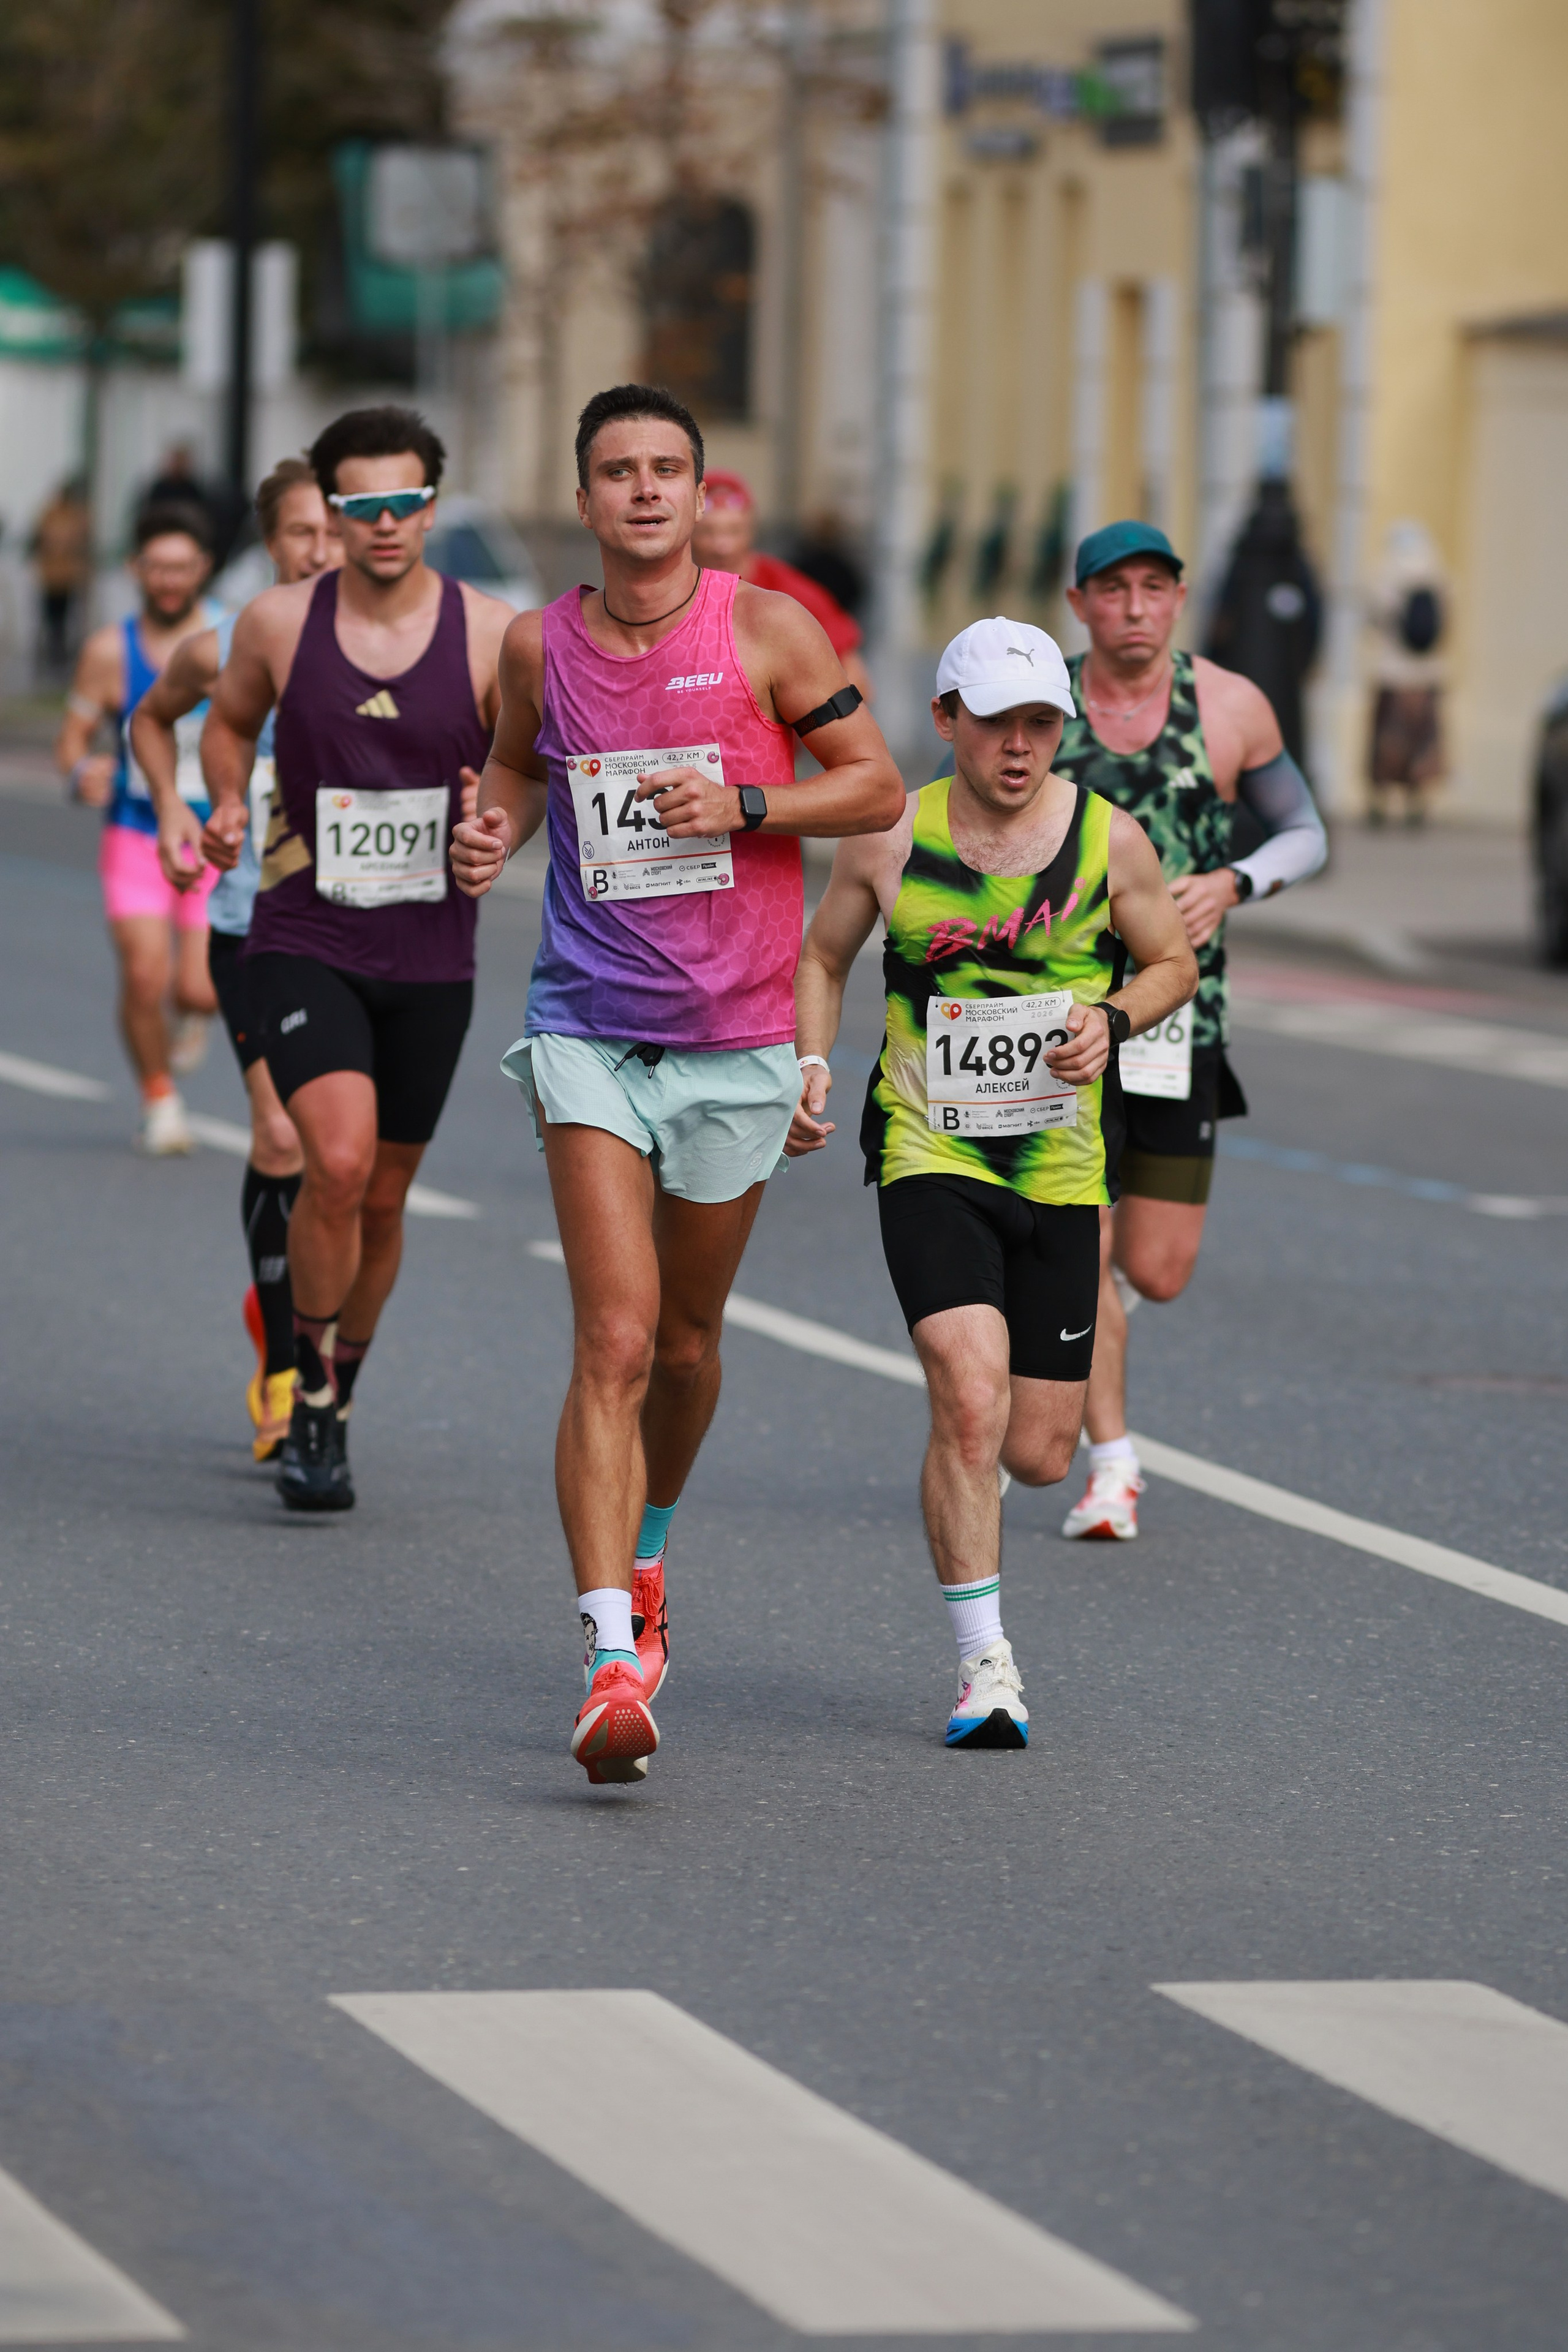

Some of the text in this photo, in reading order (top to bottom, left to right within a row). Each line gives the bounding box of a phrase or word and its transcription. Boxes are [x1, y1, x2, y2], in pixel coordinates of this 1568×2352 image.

[665, 672, 723, 690] BEEU
[605, 759, 658, 770] МОСКОВСКИЙ
[606, 767, 646, 777] МАРАФОН
[326, 820, 437, 856] 12091
[627, 837, 669, 851] АНТОН
[593, 870, 609, 894] B
[965, 1006, 1017, 1016] МОСКОВСКИЙ
[1031, 1010, 1053, 1019] 2026
[976, 1078, 1029, 1093] АЛЕКСЕЙ
[943, 1107, 960, 1130] B
